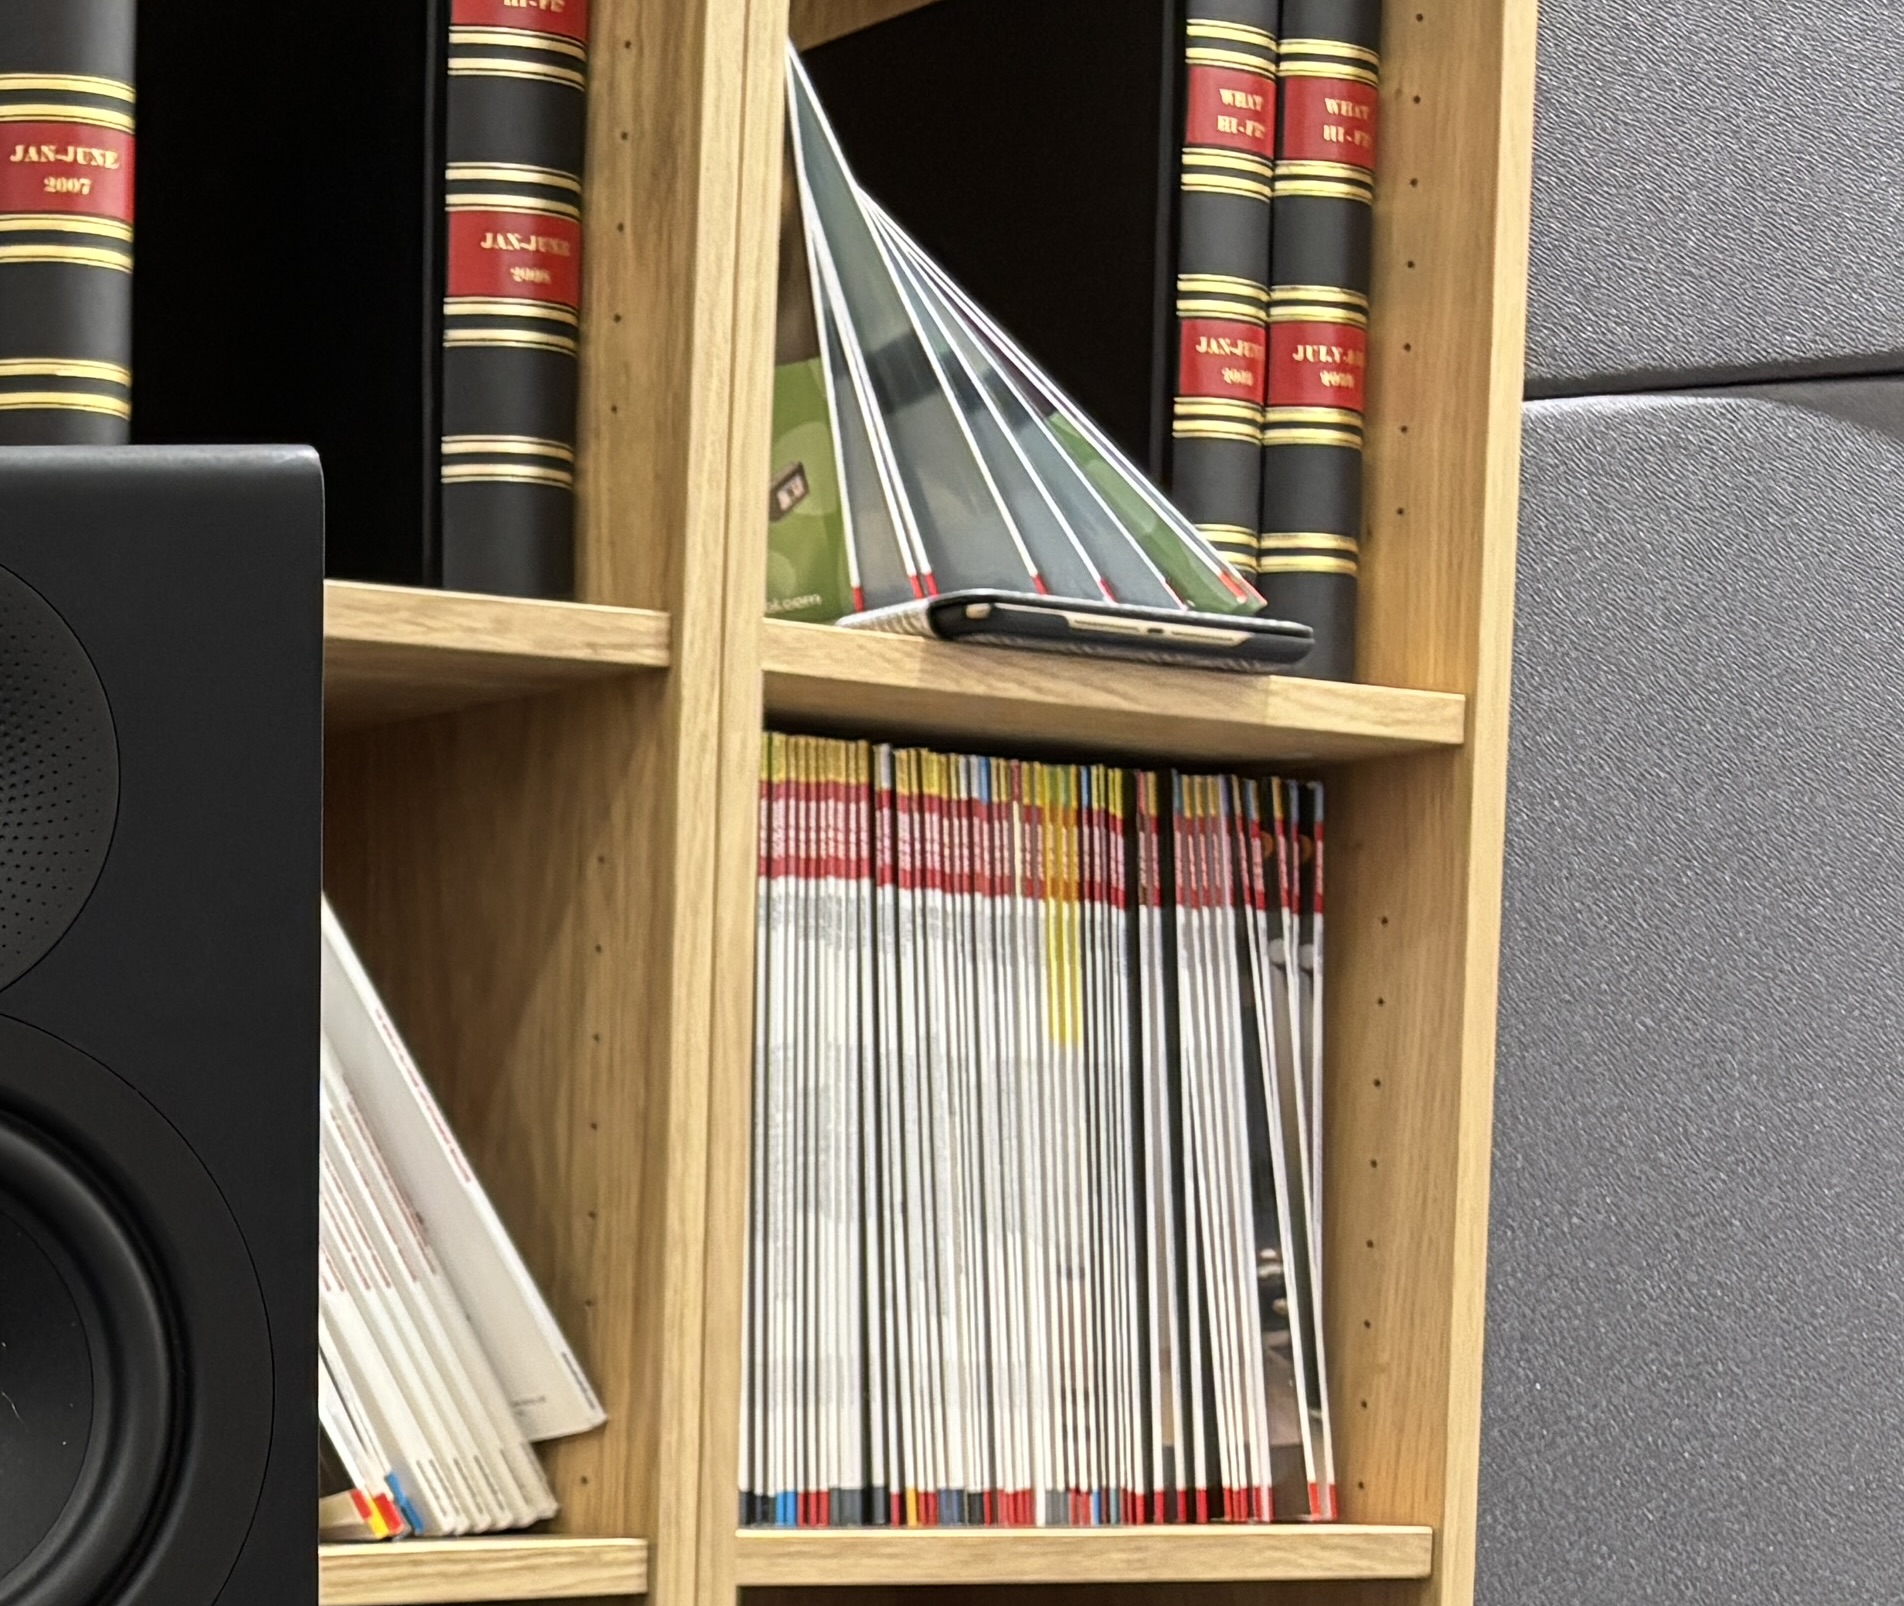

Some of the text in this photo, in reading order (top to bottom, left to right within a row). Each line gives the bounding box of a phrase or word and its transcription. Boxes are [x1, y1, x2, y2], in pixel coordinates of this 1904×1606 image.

[1219, 88, 1264, 112] WHAT
[1324, 98, 1370, 121] WHAT
[10, 145, 120, 169] JAN-JUNE
[44, 178, 92, 195] 2007
